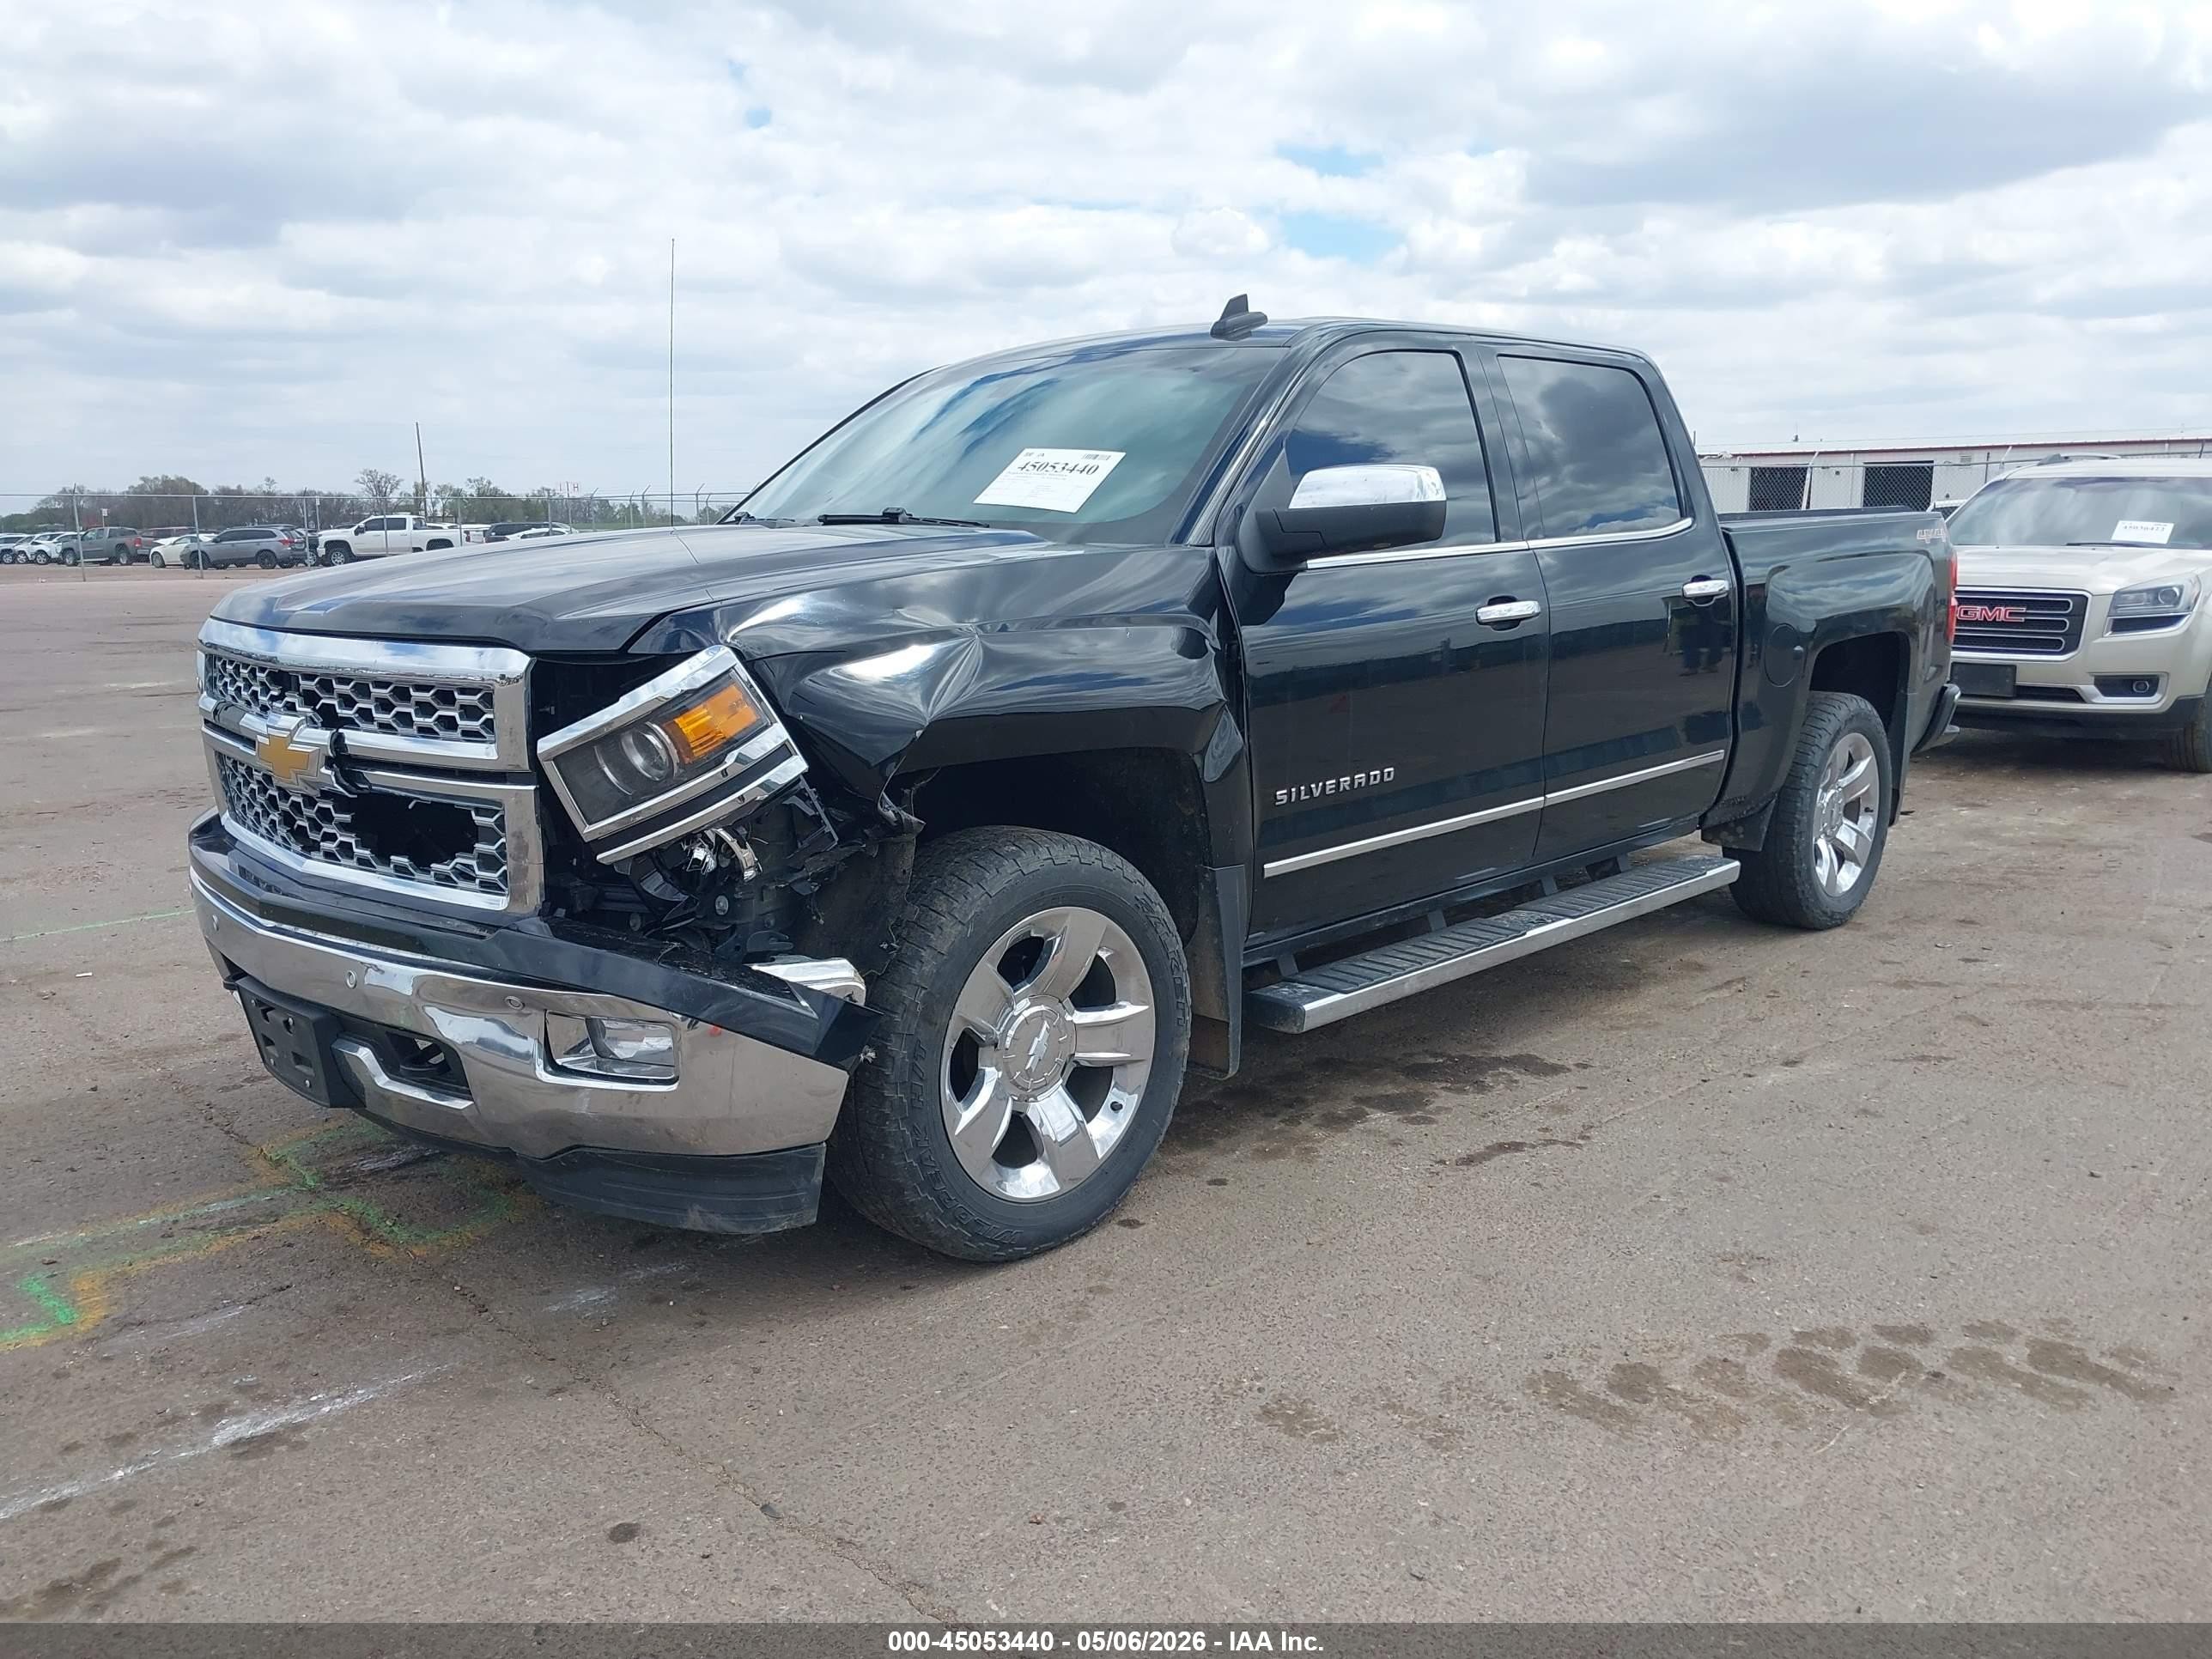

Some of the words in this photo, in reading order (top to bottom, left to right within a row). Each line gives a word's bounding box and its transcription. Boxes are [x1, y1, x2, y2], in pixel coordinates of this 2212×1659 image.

[1018, 461, 1099, 475] 45053440
[1957, 605, 2027, 623] GMC
[1275, 767, 1395, 805] SILVERADO
